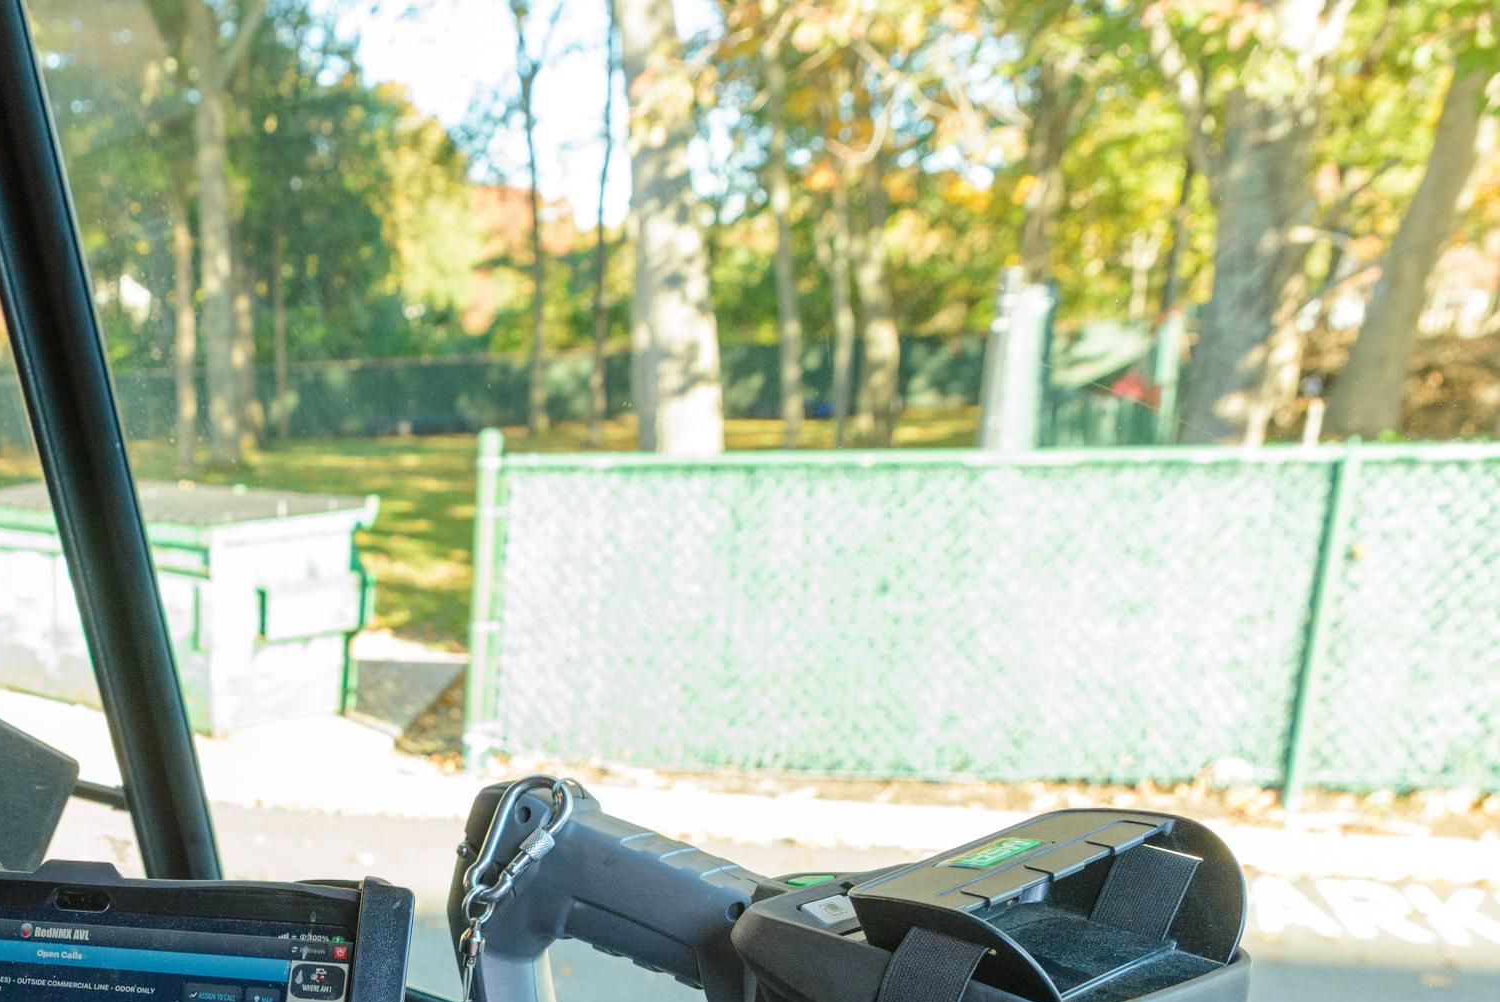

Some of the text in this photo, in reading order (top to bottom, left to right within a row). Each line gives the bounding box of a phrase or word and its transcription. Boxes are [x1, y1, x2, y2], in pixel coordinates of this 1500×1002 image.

[73, 929, 90, 941] AVL
[36, 949, 83, 960] Open Calls
[16, 977, 46, 986] OUTSIDE
[47, 980, 93, 990] COMMERCIAL
[114, 985, 136, 993] ODOR
[136, 986, 156, 994] ONLY
[302, 984, 320, 992] WHERE
[224, 994, 236, 1002] CALL
